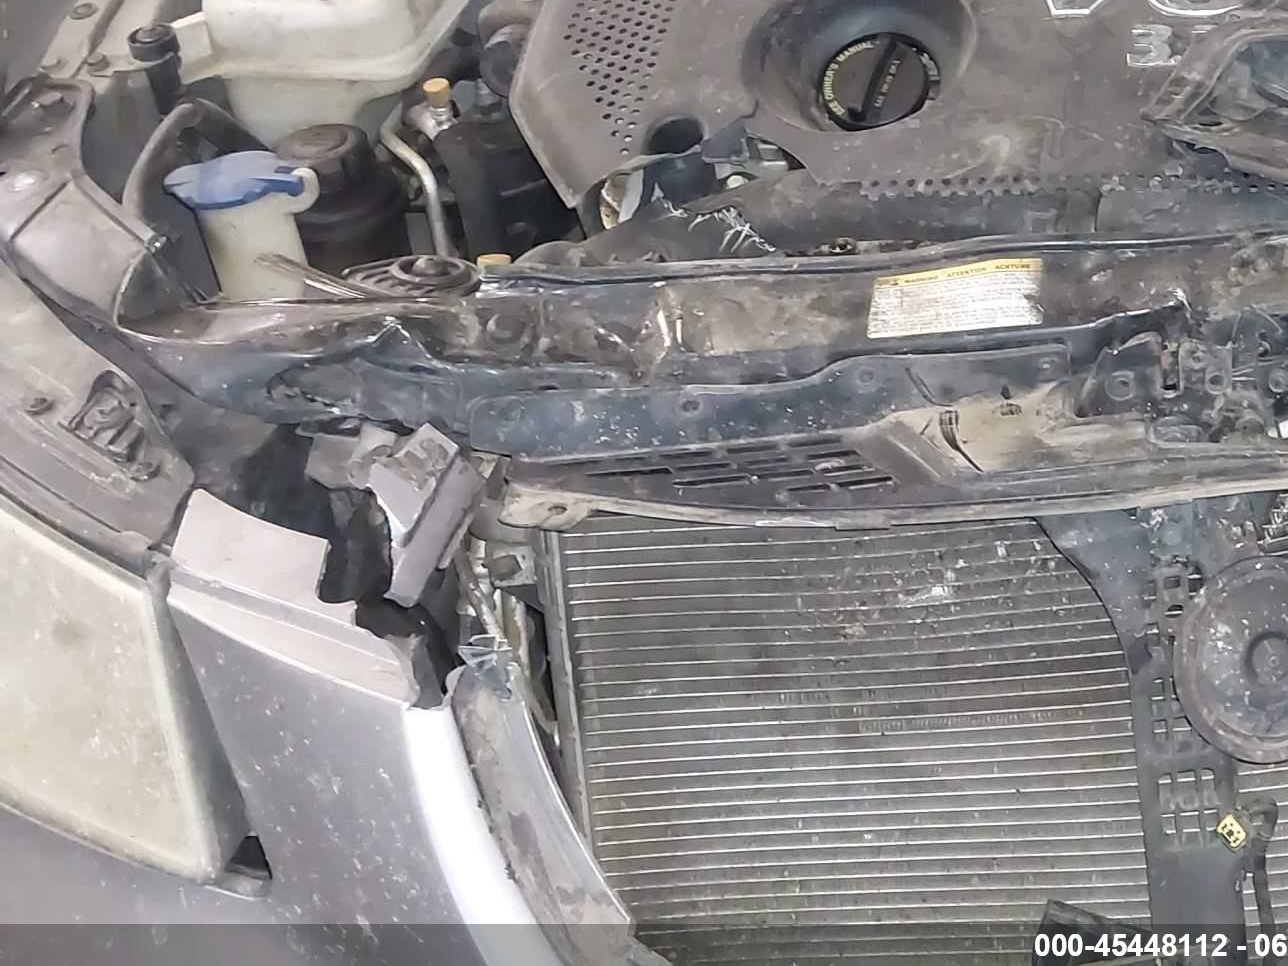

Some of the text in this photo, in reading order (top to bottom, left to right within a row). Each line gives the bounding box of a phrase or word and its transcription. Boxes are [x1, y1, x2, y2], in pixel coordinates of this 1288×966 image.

[836, 41, 875, 62] MANUAL
[1126, 23, 1219, 67] 3.
[947, 267, 987, 278] ATTENTION
